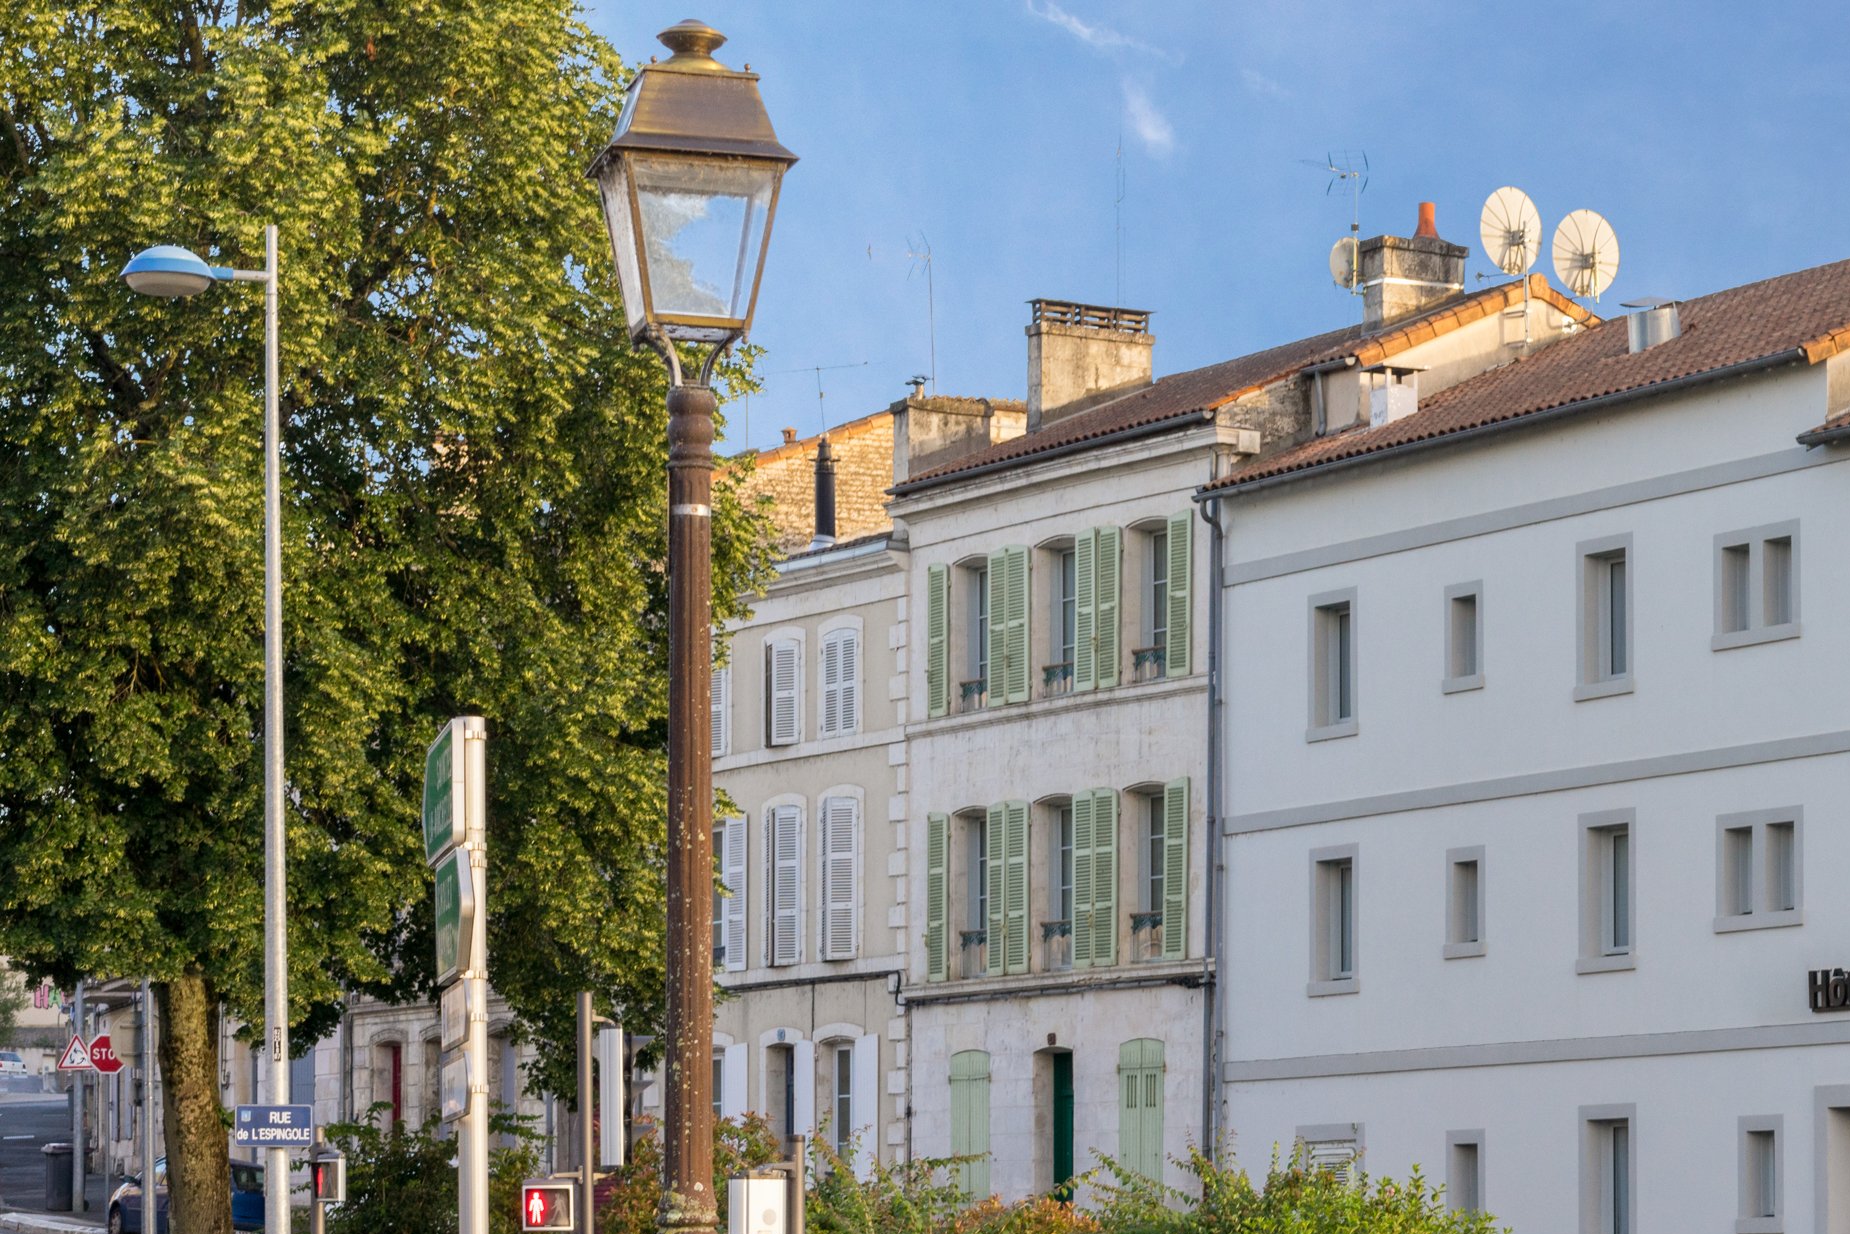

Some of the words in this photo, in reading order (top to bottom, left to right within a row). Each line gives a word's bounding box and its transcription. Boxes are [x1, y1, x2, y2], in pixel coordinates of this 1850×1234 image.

[92, 1048, 116, 1061] STO
[269, 1111, 292, 1124] RUE
[237, 1128, 249, 1140] de
[251, 1128, 310, 1141] L'ESPINGOLE
